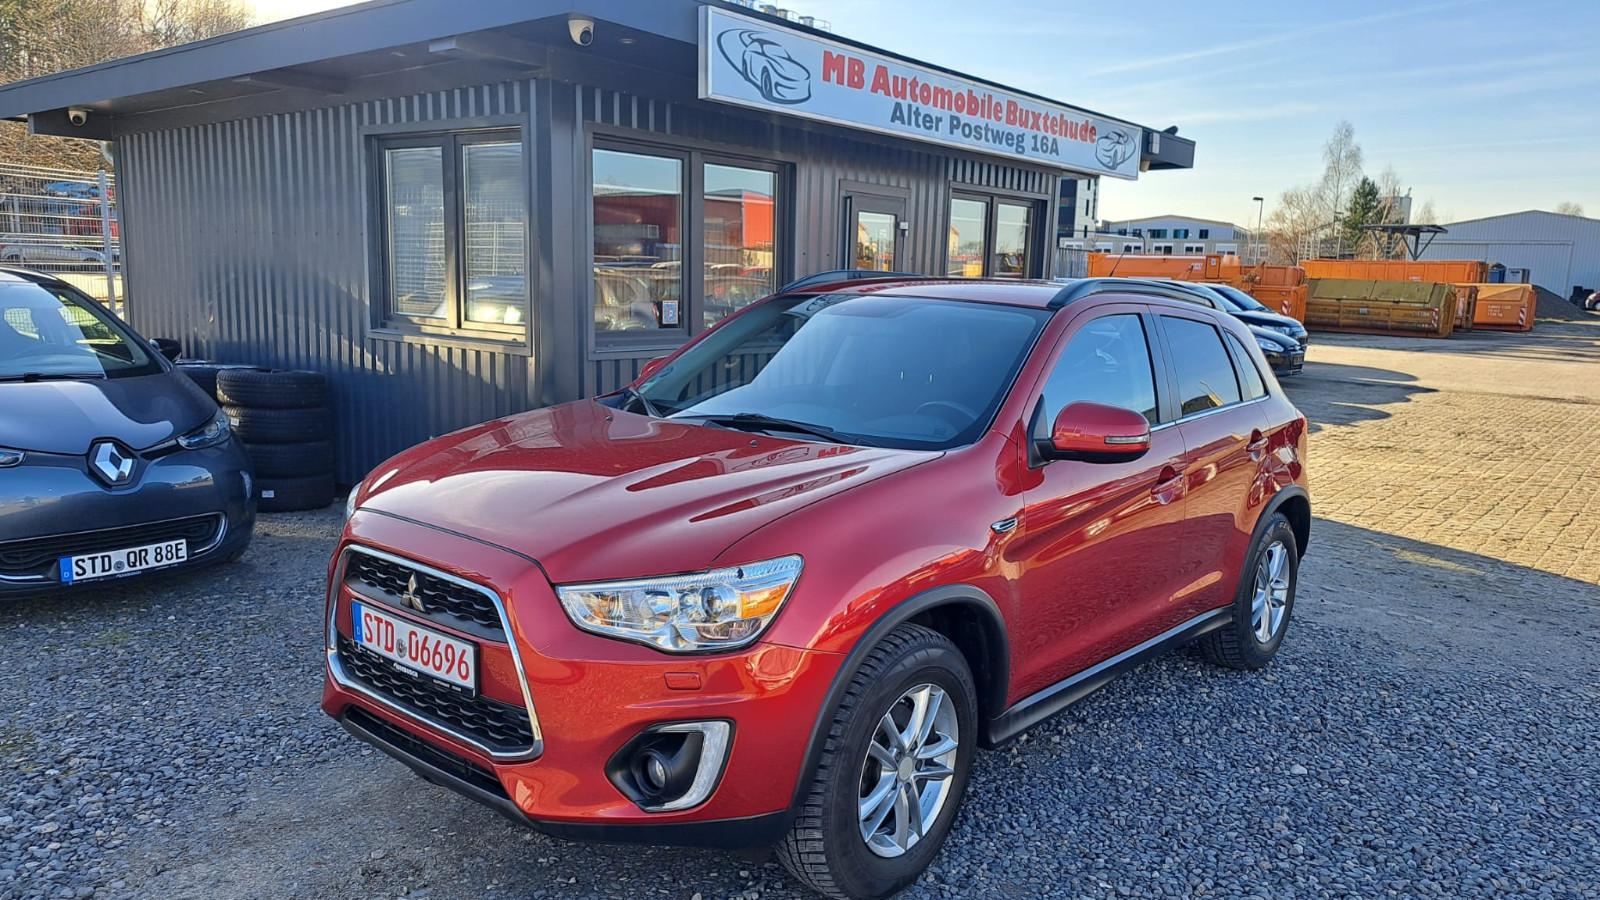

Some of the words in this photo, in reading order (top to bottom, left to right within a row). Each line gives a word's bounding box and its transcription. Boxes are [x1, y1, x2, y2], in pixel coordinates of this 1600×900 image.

[822, 50, 865, 90] MB
[870, 64, 1003, 122] Automobile
[1005, 100, 1097, 144] Buxtehude
[890, 101, 943, 132] Alter
[949, 115, 1026, 154] Postweg
[1031, 134, 1060, 156] 16A
[75, 554, 112, 577] STD
[126, 548, 149, 568] QR
[154, 542, 185, 563] 88E
[364, 612, 395, 653] STD
[408, 630, 470, 681] 06696
